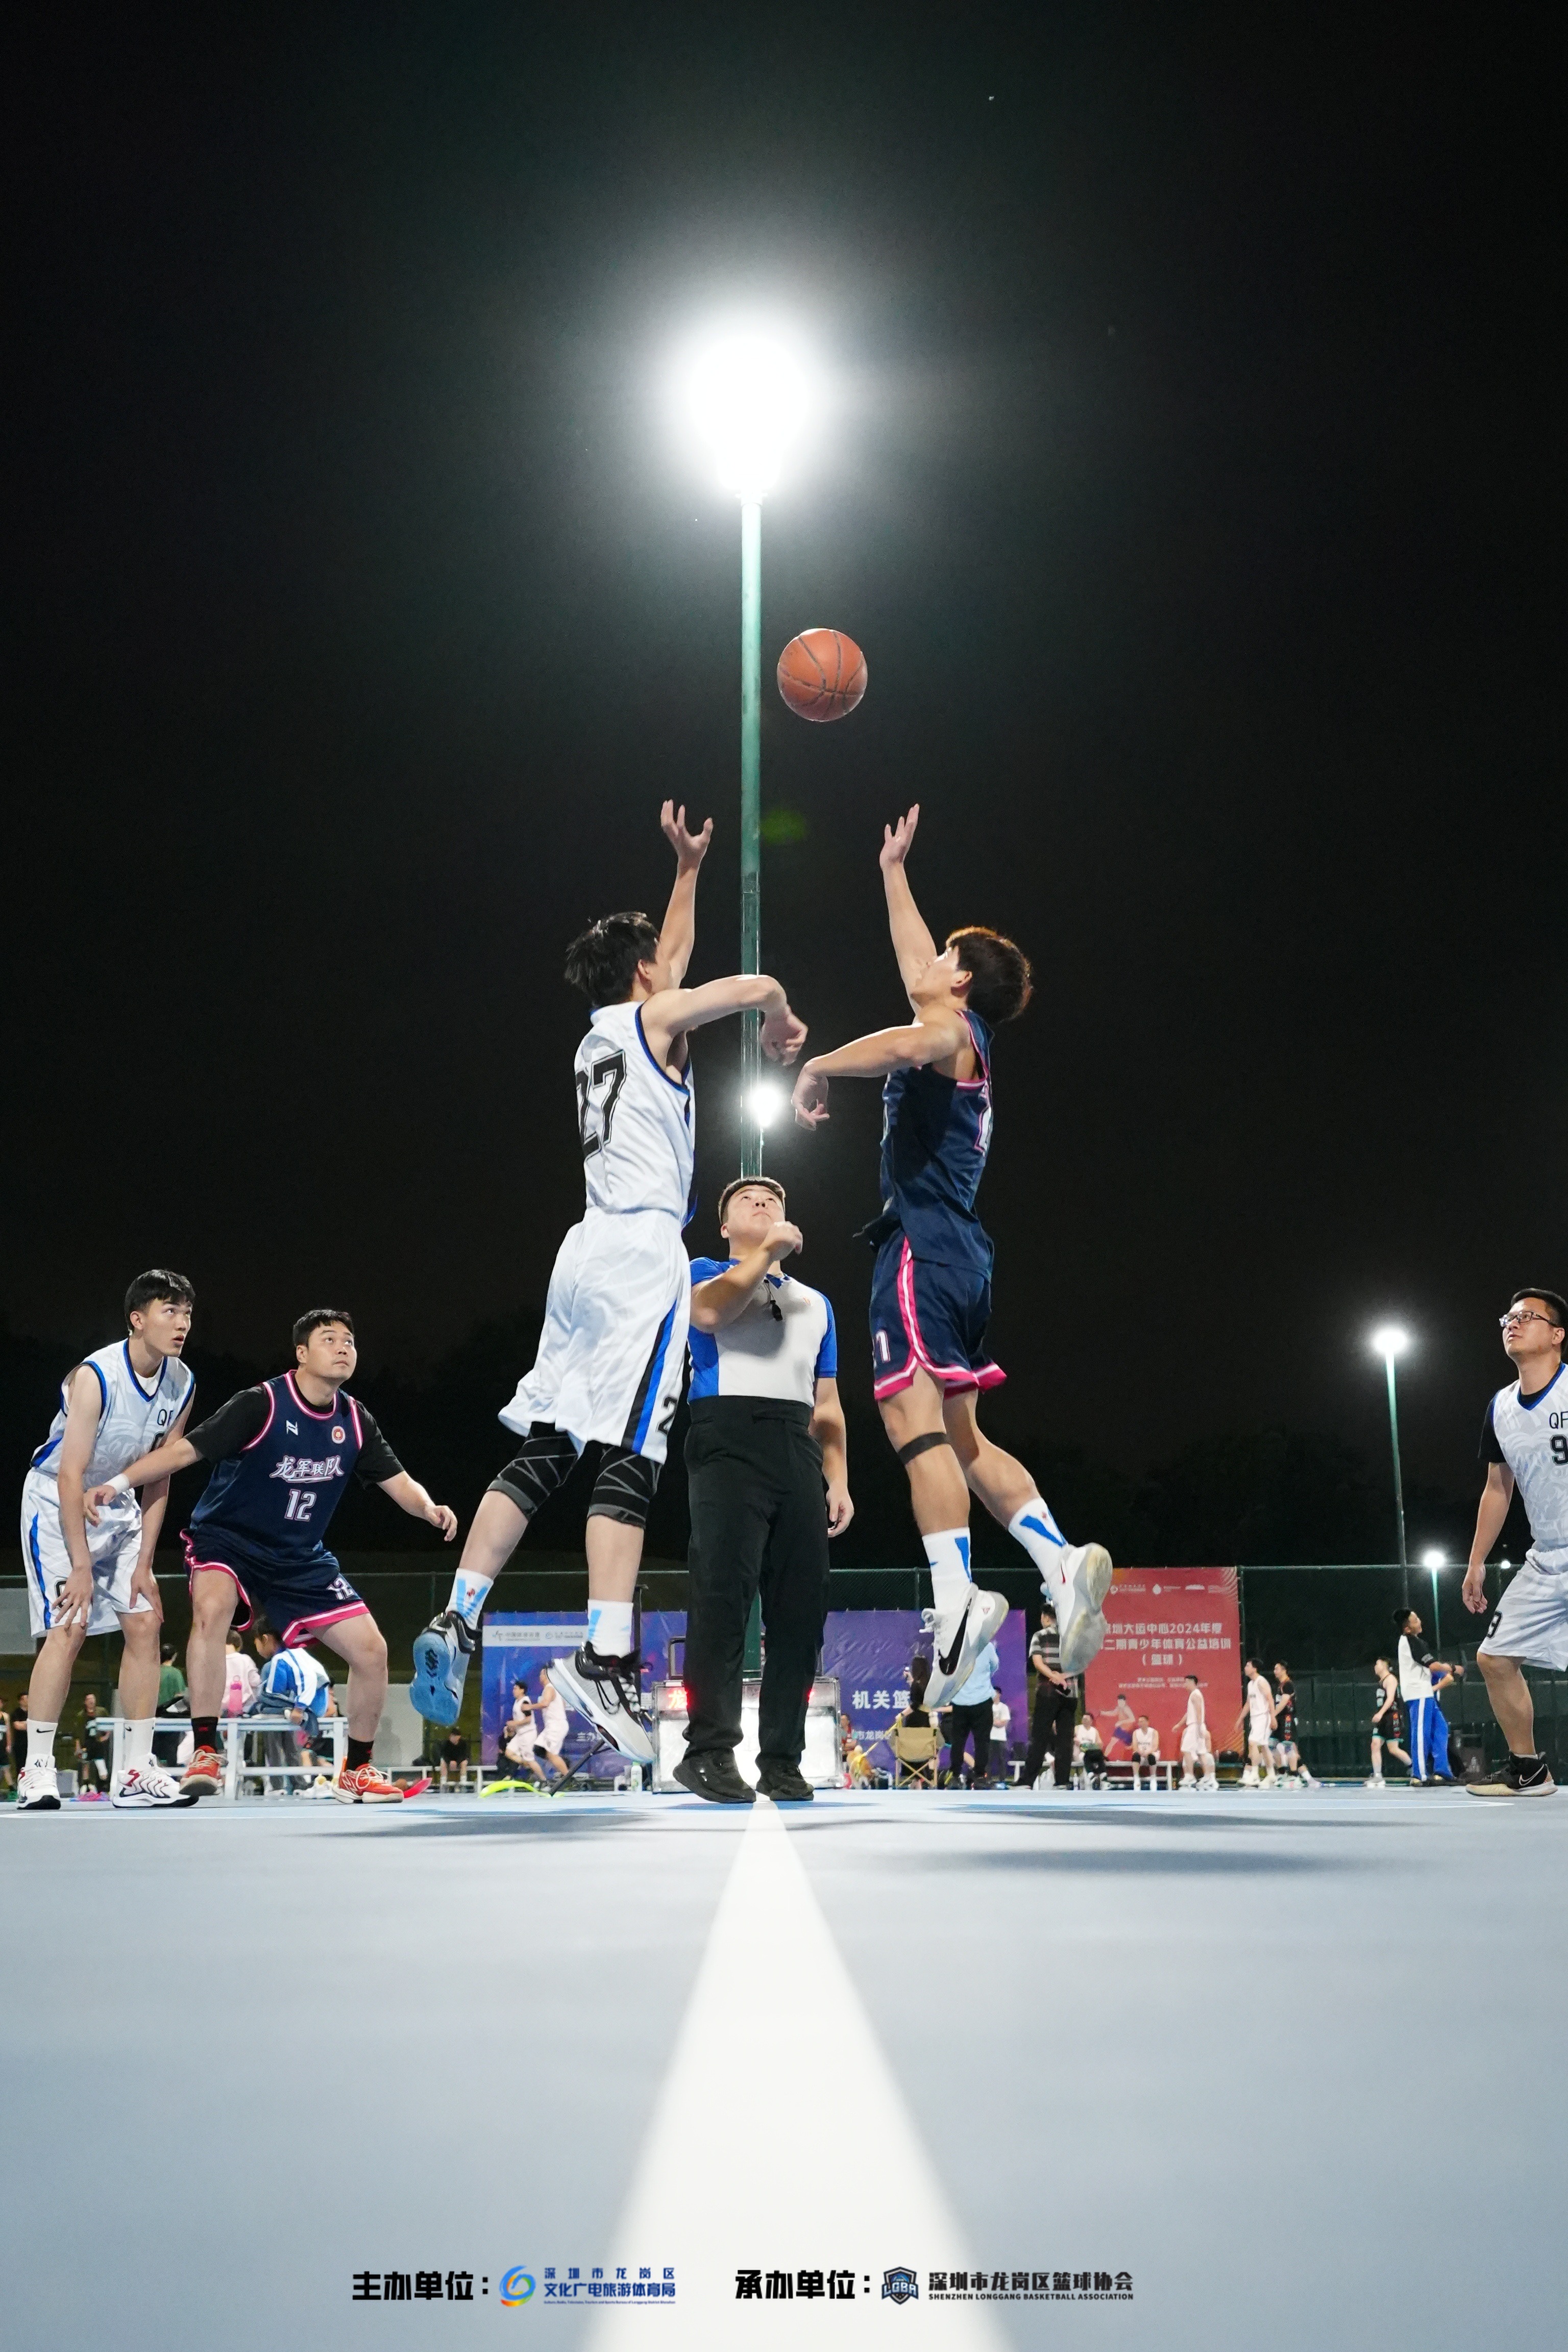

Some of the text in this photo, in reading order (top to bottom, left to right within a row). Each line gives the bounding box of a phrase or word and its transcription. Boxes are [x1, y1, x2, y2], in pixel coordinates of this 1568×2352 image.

[1550, 1434, 1568, 1466] 9
[270, 1455, 344, 1480] 龙军联队
[284, 1489, 316, 1522] 12
[327, 1577, 354, 1600] 12
